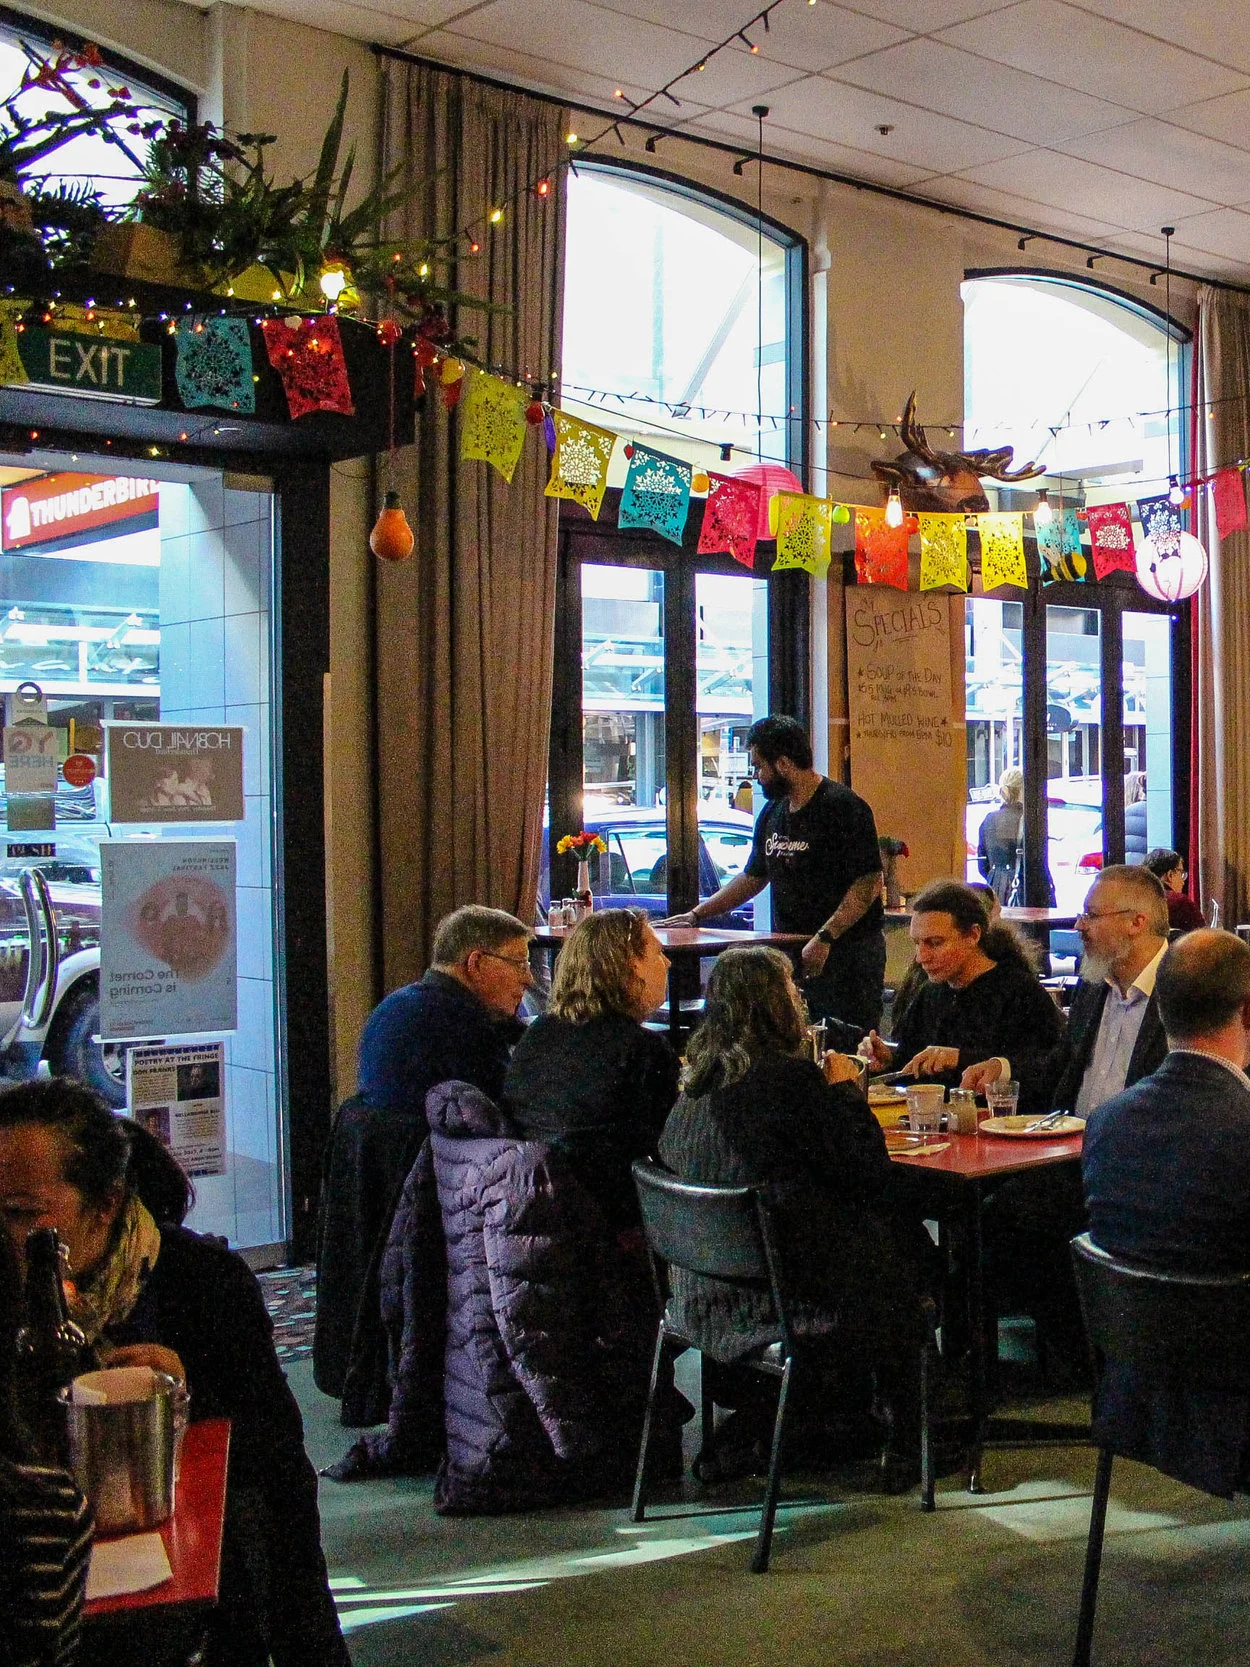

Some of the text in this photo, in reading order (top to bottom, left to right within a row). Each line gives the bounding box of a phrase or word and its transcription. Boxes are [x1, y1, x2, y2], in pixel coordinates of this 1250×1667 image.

[50, 338, 131, 387] EXIT
[853, 601, 942, 647] SPECIALS
[866, 663, 895, 680] SOUP
[924, 667, 942, 684] DAY
[857, 712, 875, 726] HOT
[134, 1052, 219, 1066] POETRY AT THE FRINGE
